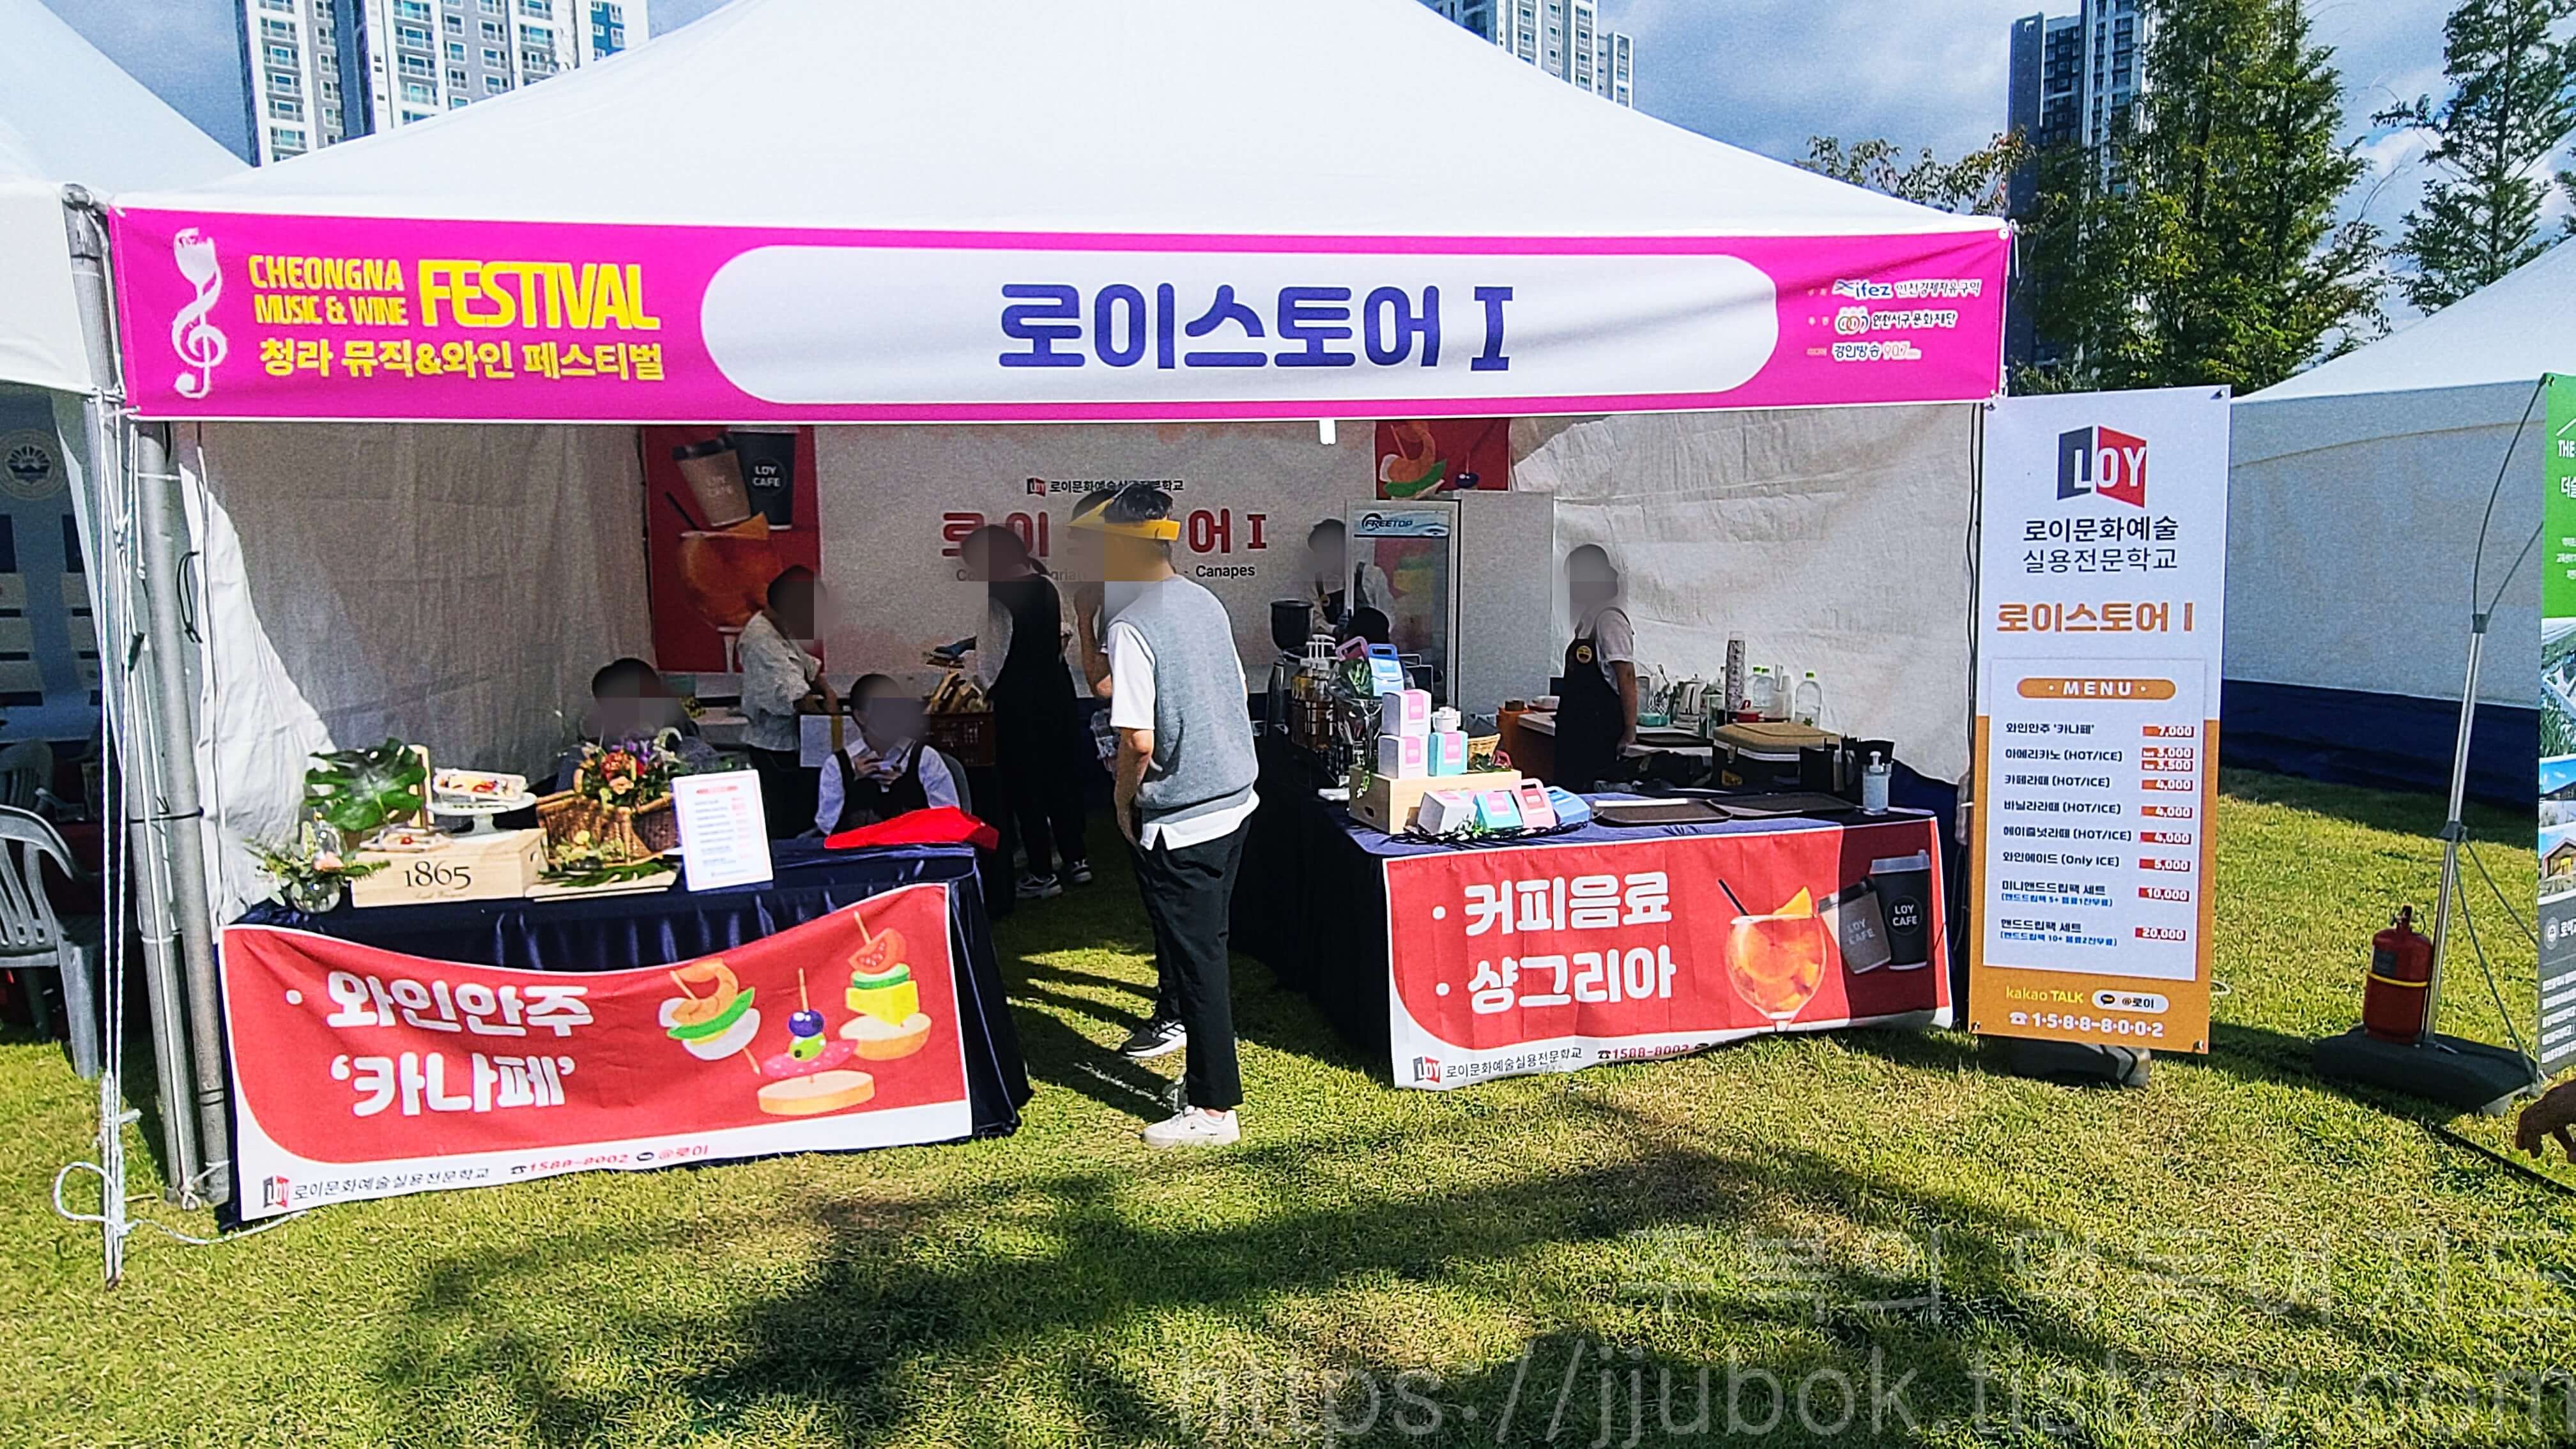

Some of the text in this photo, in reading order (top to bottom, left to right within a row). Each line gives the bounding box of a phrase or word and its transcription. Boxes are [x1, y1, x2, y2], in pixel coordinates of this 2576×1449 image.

[248, 255, 403, 291] CHEONGNA
[418, 259, 661, 330] FESTIVAL
[1855, 282, 1891, 298] ifez
[254, 295, 409, 326] MUSIC & WINE
[999, 282, 1439, 369] 로이스토어
[259, 337, 664, 381] 청라 뮤직&와인 페스티벌
[1834, 344, 1880, 359] 경인방송
[2073, 447, 2147, 489] LOY
[1365, 519, 1413, 528] FREETOP
[2023, 516, 2179, 543] 로이문화예술
[2023, 548, 2178, 574] 실용전문학교
[1195, 565, 1256, 579] Canapes
[1997, 602, 2168, 632] 로이스토어
[2063, 681, 2131, 696] MENU
[2005, 723, 2050, 734] 와인안주
[2158, 726, 2192, 737] 7,000
[2005, 748, 2122, 762] 아메리카노 (HOT/ICE)
[2005, 774, 2110, 788] 카페라떼 (HOT/ICE)
[2156, 779, 2191, 790] 4,000
[2004, 800, 2121, 815] 바닐라라떼 (HOT/ICE)
[2155, 806, 2191, 818] 4,000
[2003, 825, 2132, 842] 헤이즐넛라떼 (HOT/ICE)
[2154, 832, 2190, 843] 4,000
[2002, 852, 2120, 868] 와인에이드 (Only ICE)
[2154, 860, 2189, 871] 5,000
[404, 860, 471, 890] 1865
[2083, 884, 2106, 896] 세트
[2147, 888, 2188, 901] 10,000
[1464, 871, 1671, 937] 커피음료
[1894, 905, 1914, 914] LOY
[1847, 918, 1866, 933] LOY
[1892, 916, 1917, 926] CAFE
[2059, 923, 2082, 933] 세트
[1848, 928, 1876, 945] CAFE
[2142, 928, 2184, 940] 20,000
[1467, 945, 1676, 1015] 샹그리아
[2005, 986, 2048, 1002] kakao
[2051, 990, 2083, 1004] TALK
[326, 971, 595, 1038] 와인안주
[1446, 1047, 1583, 1078] 로이문화예술실용전문학교
